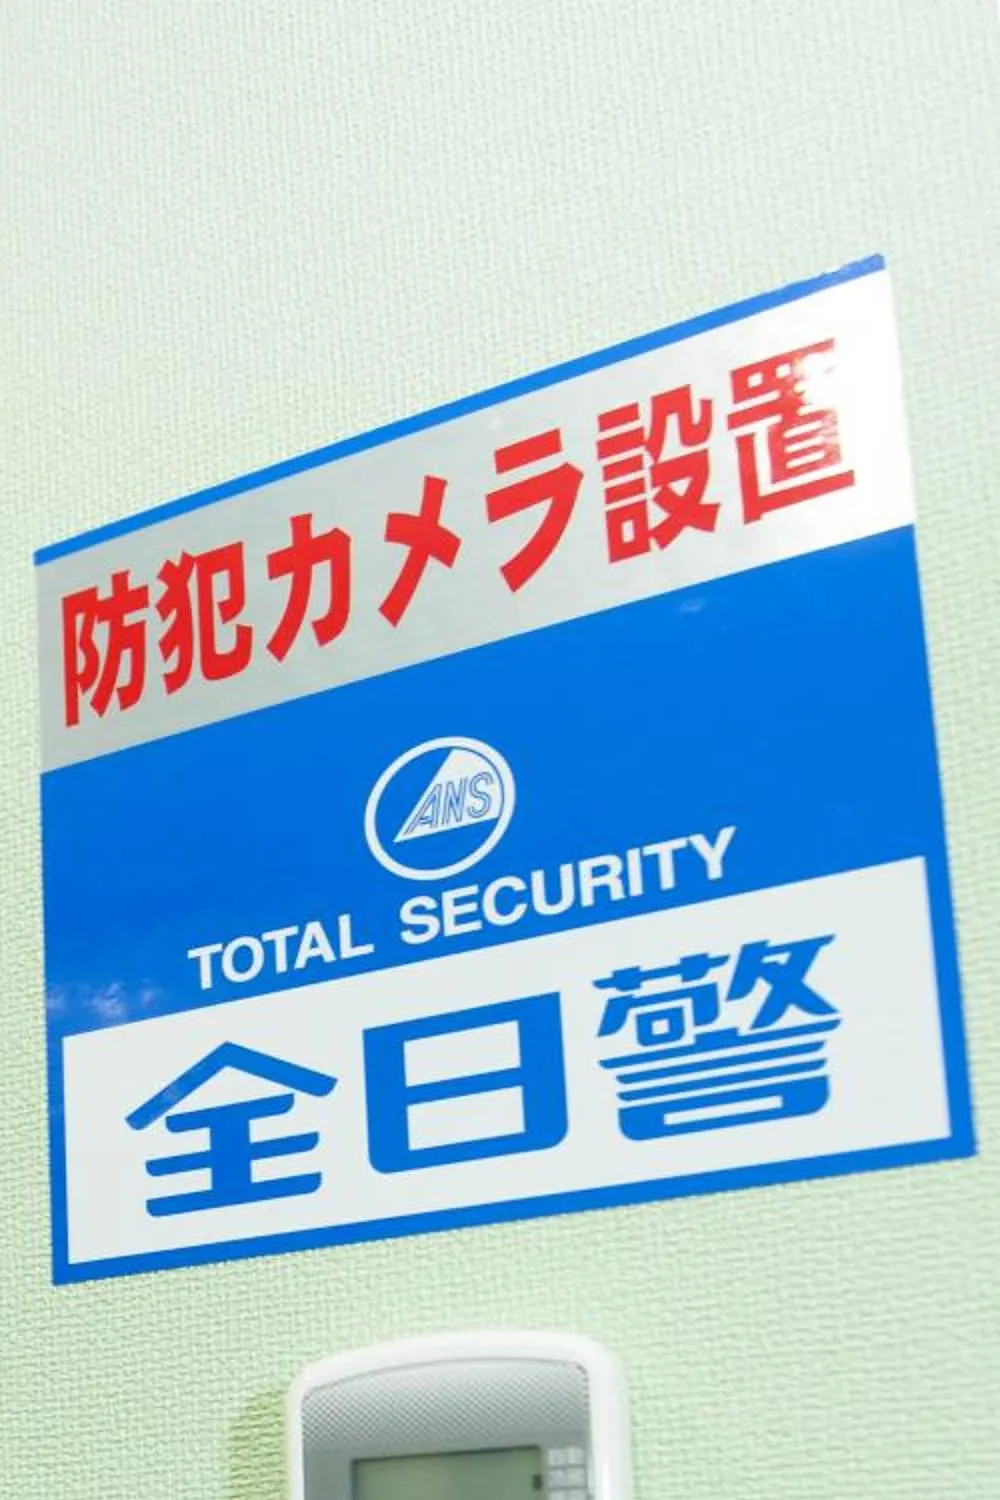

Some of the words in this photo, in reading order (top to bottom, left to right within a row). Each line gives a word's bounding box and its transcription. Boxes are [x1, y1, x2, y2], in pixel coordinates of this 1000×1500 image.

[61, 338, 855, 728] 防犯カメラ設置
[188, 911, 375, 991] TOTAL
[399, 825, 738, 945] SECURITY
[403, 771, 494, 836] ANS
[124, 933, 843, 1218] 全日警
